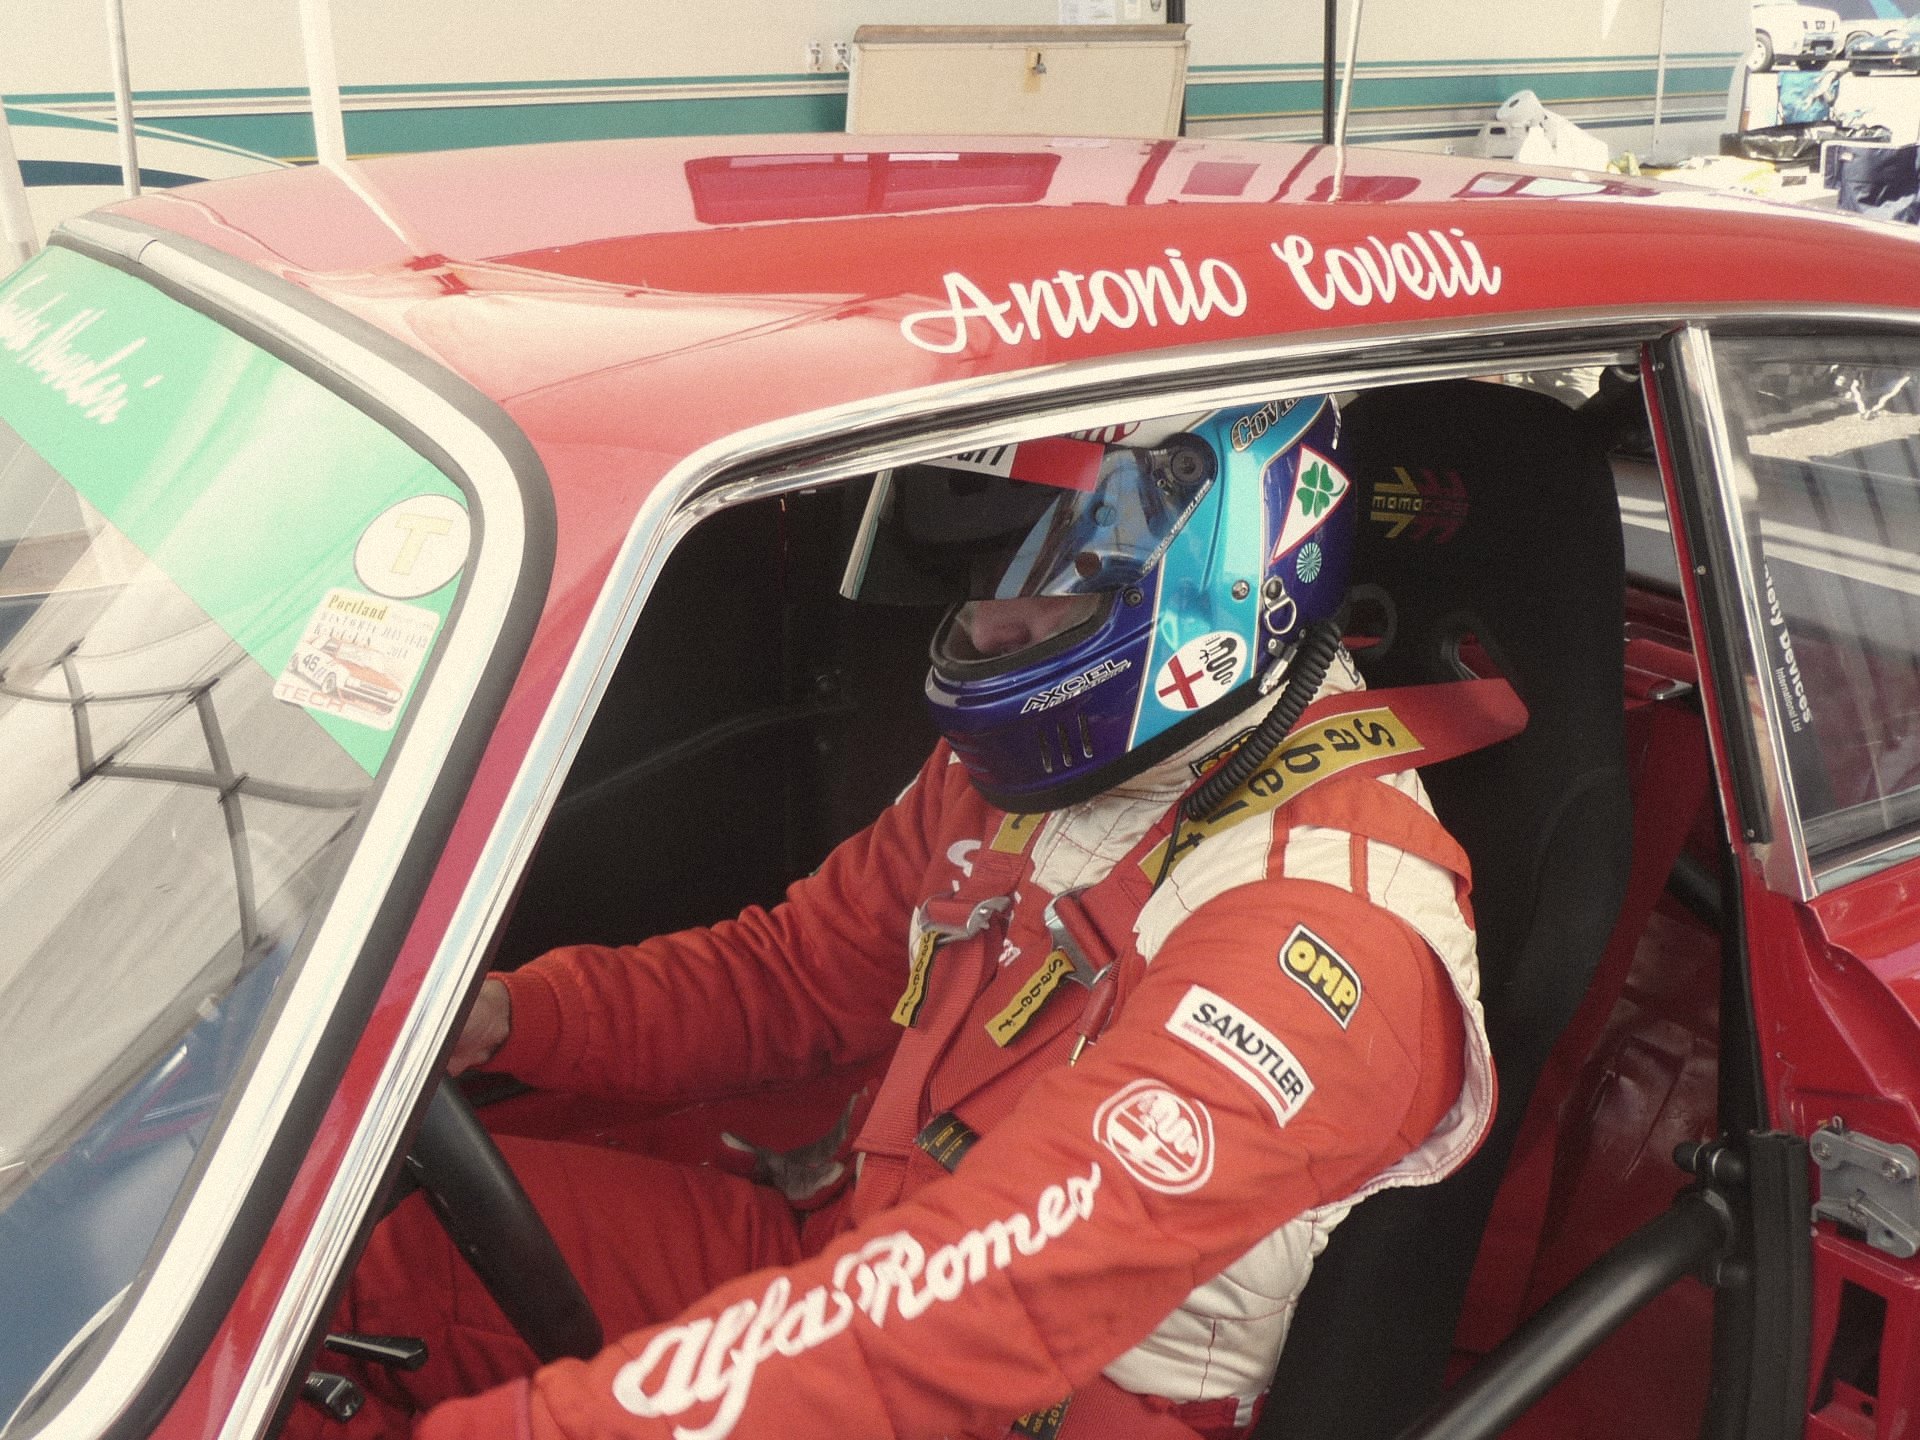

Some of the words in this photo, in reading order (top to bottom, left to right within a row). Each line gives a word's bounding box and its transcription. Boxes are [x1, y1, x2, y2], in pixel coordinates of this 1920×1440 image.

[900, 248, 1248, 355] Antonio
[1270, 227, 1502, 311] Covelli
[1372, 495, 1423, 512] momo
[389, 513, 454, 577] T
[328, 594, 390, 622] Portland
[281, 683, 345, 712] TECH
[1020, 659, 1129, 714] AXCEL
[1779, 626, 1814, 724] Devices
[998, 958, 1064, 1032] Sabelt
[1287, 940, 1358, 1008] OMP
[1191, 1002, 1305, 1104] SANDTLER
[612, 1275, 854, 1440] Alfa
[832, 1162, 1101, 1328] Romeo
